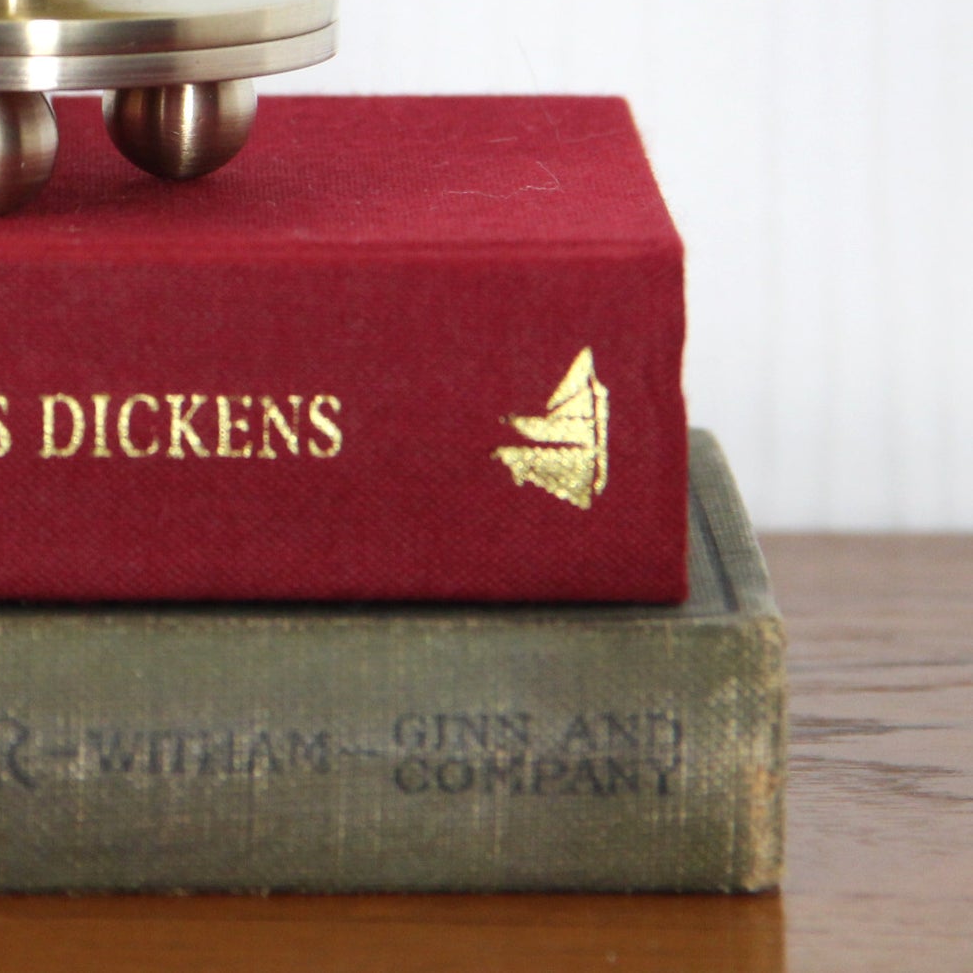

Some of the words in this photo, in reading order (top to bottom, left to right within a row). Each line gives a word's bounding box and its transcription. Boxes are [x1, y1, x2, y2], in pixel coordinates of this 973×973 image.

[40, 392, 344, 459] DICKENS
[564, 712, 682, 749] AND
[394, 756, 680, 795] COMPANY
